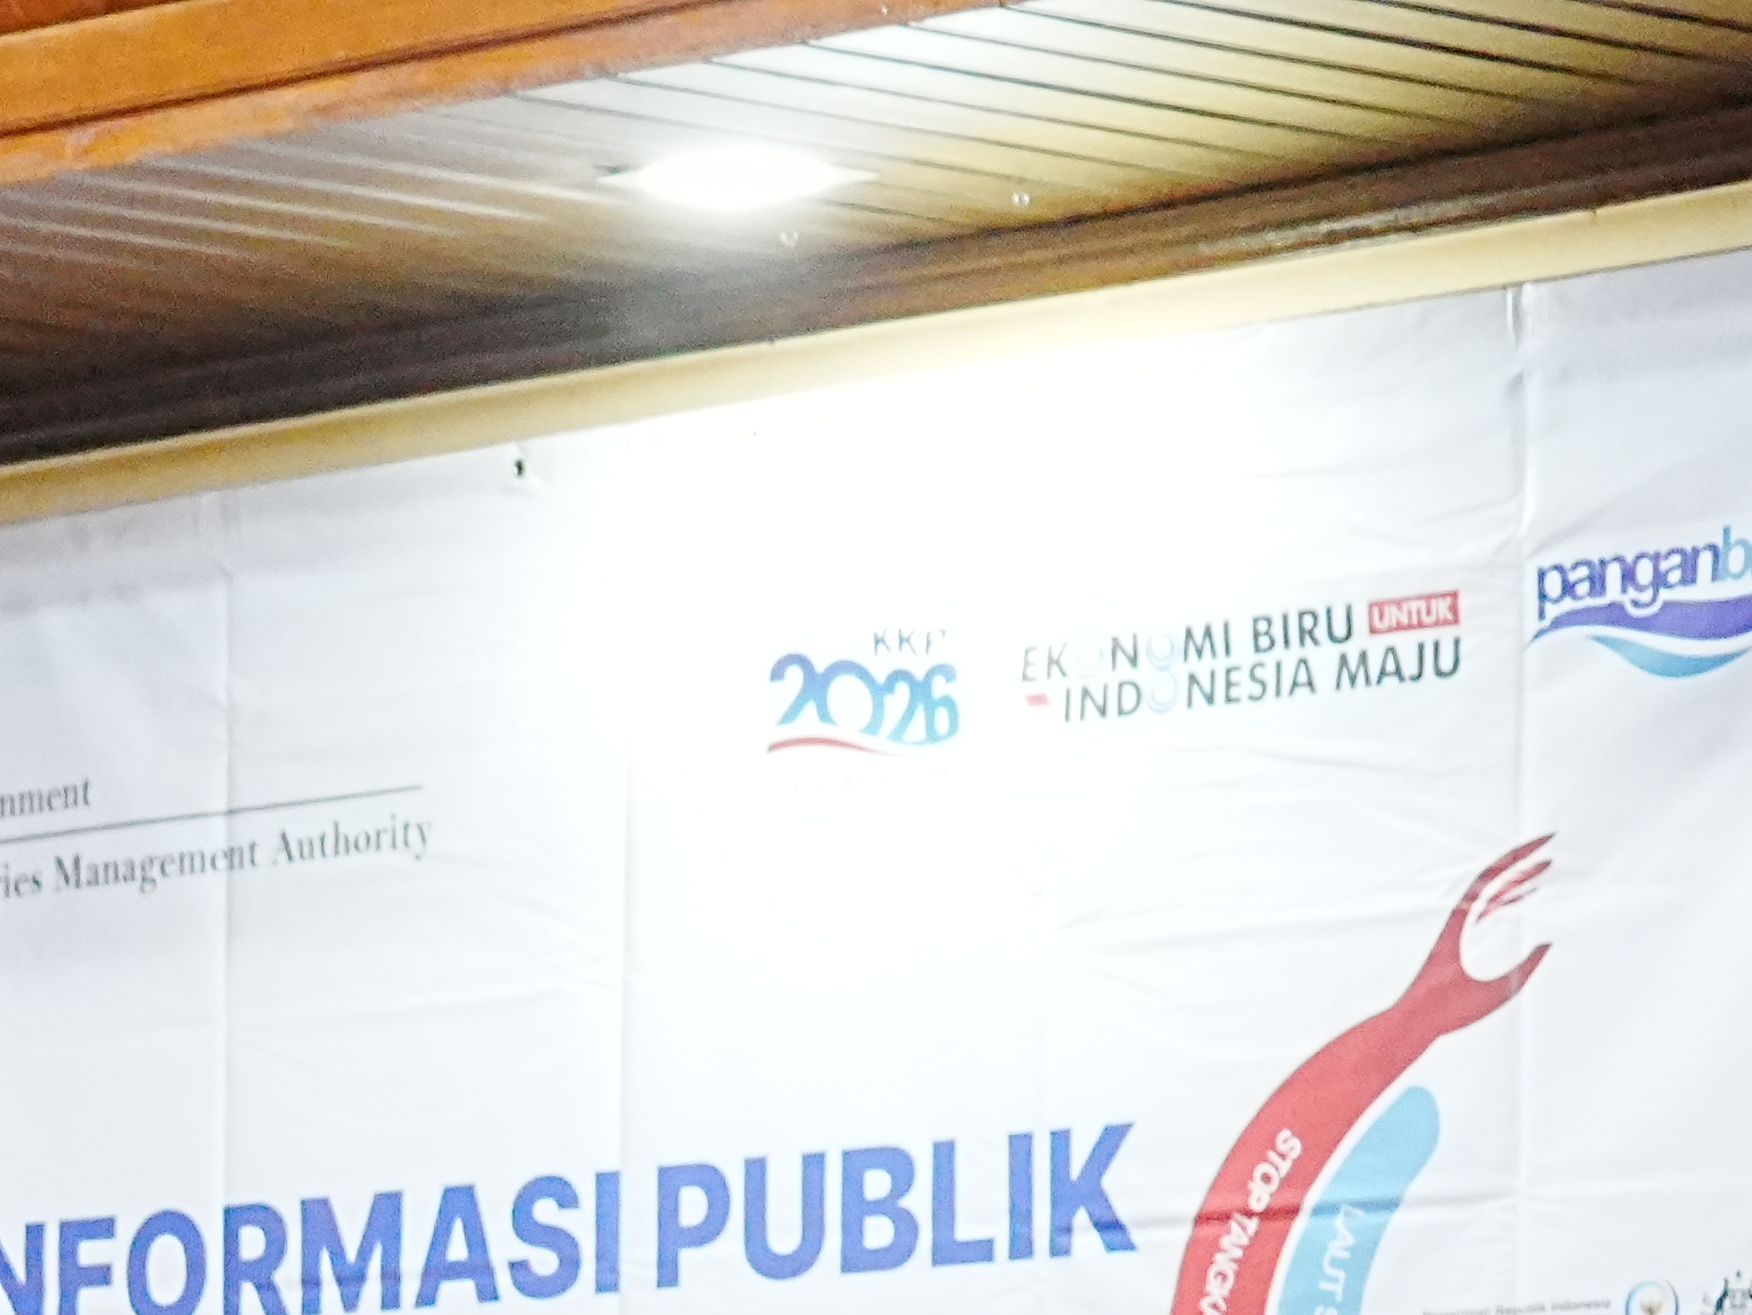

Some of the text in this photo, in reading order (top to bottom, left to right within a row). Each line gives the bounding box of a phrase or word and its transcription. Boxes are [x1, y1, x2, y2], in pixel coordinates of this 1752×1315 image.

[1251, 603, 1354, 656] BIRU
[1370, 597, 1458, 632] UNTUK
[769, 652, 960, 746] 2026
[1064, 637, 1463, 723] INDONESIA MAJU
[52, 836, 259, 895] Management
[272, 814, 434, 867] Authority
[657, 1124, 1135, 1287] PUBLIK
[1248, 1128, 1302, 1212] STOP
[1318, 1204, 1365, 1302] LAUT
